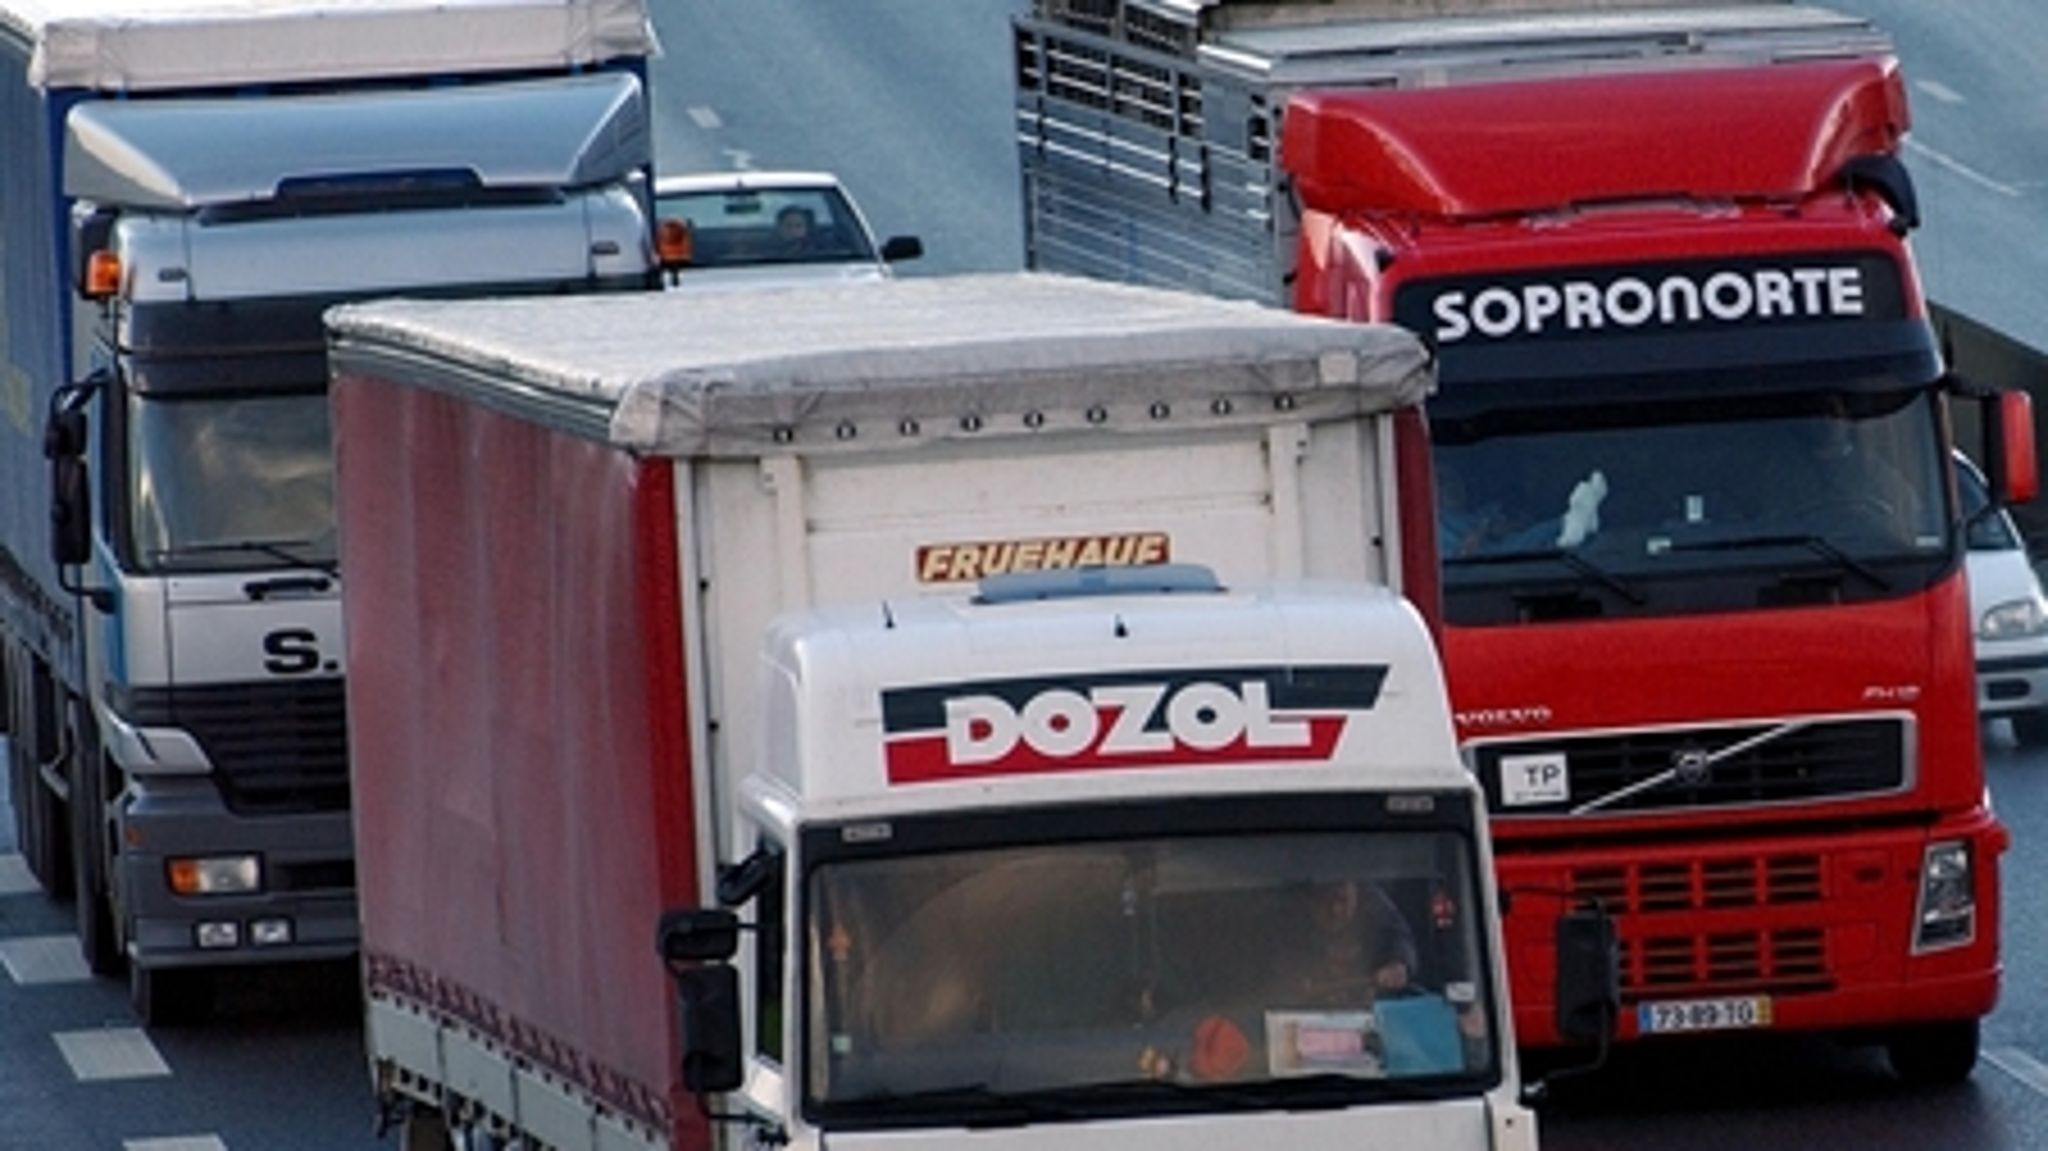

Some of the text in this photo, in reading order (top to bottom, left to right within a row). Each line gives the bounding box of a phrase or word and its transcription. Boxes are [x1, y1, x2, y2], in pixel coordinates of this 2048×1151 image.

[1433, 268, 1864, 341] SOPRONORTE
[922, 535, 1168, 580] FRUEHAUF
[944, 681, 1312, 766] DOZOL
[1455, 705, 1553, 726] VOLVO
[1525, 764, 1561, 786] TP
